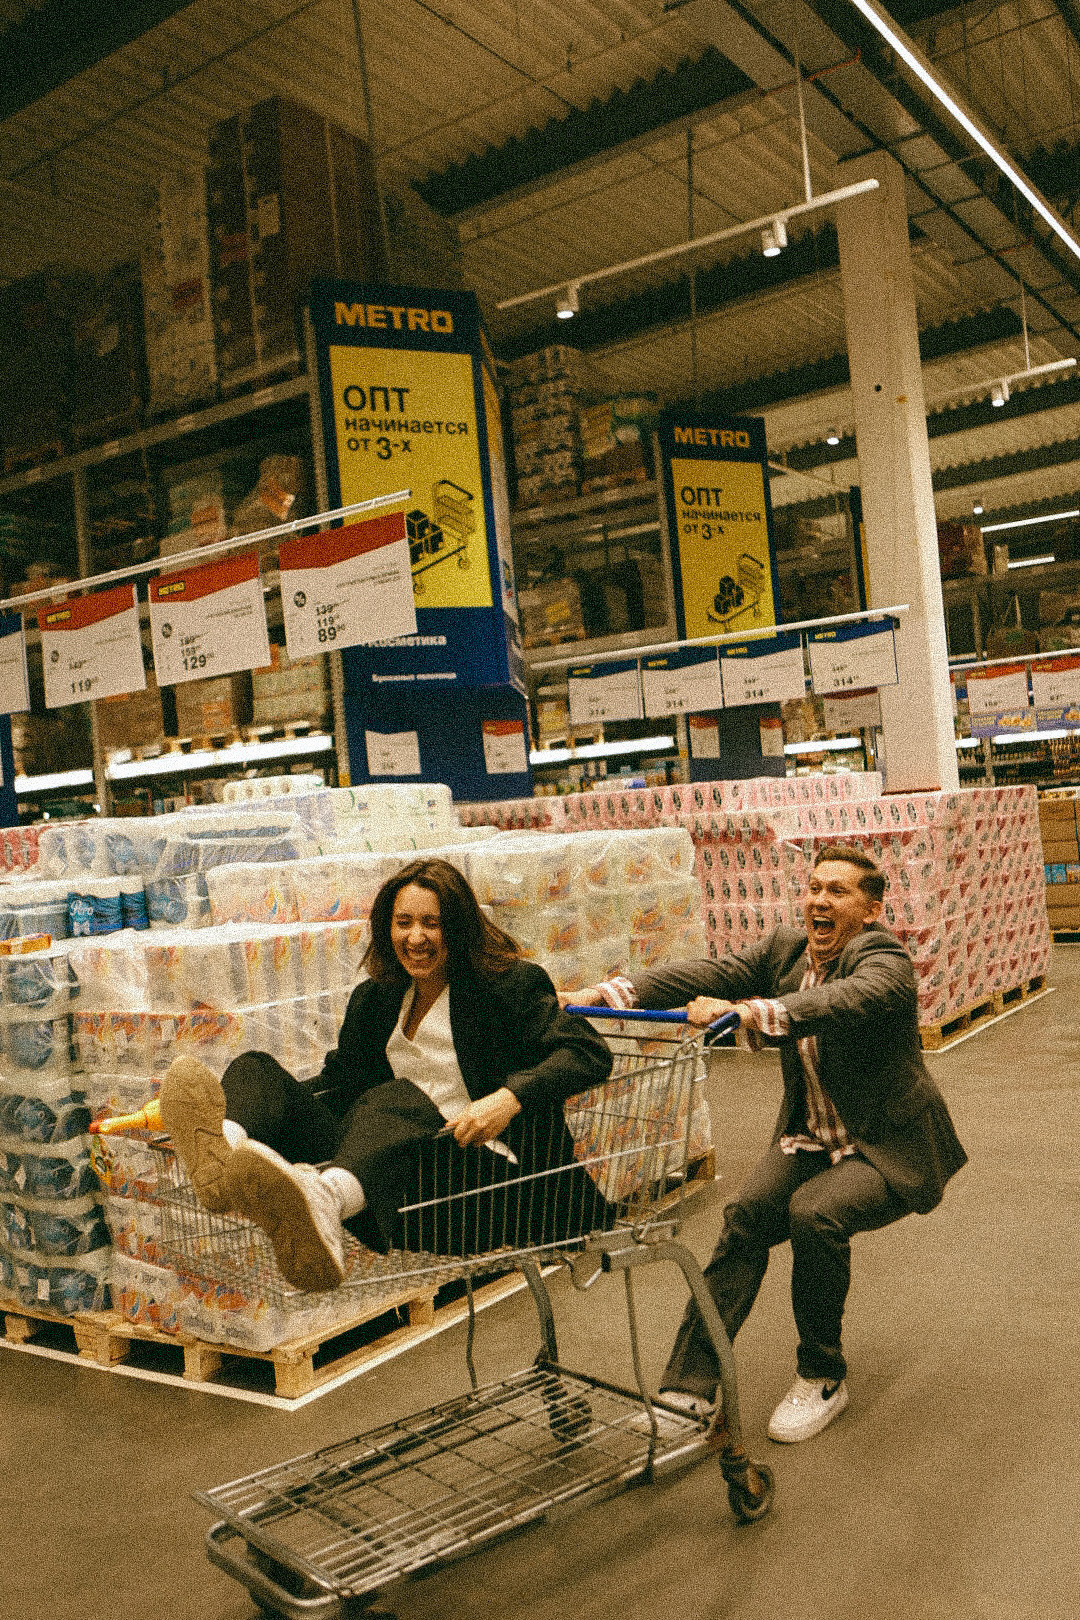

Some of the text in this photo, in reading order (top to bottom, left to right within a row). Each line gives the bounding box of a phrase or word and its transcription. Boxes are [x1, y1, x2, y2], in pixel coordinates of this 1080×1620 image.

[334, 302, 453, 334] METRO
[343, 385, 410, 412] ОПТ
[345, 418, 469, 435] начинается
[347, 437, 371, 452] от
[674, 426, 751, 449] METRO
[681, 486, 723, 507] ОПТ
[682, 509, 762, 522] начинается
[683, 524, 698, 534] от
[183, 654, 207, 671] 129
